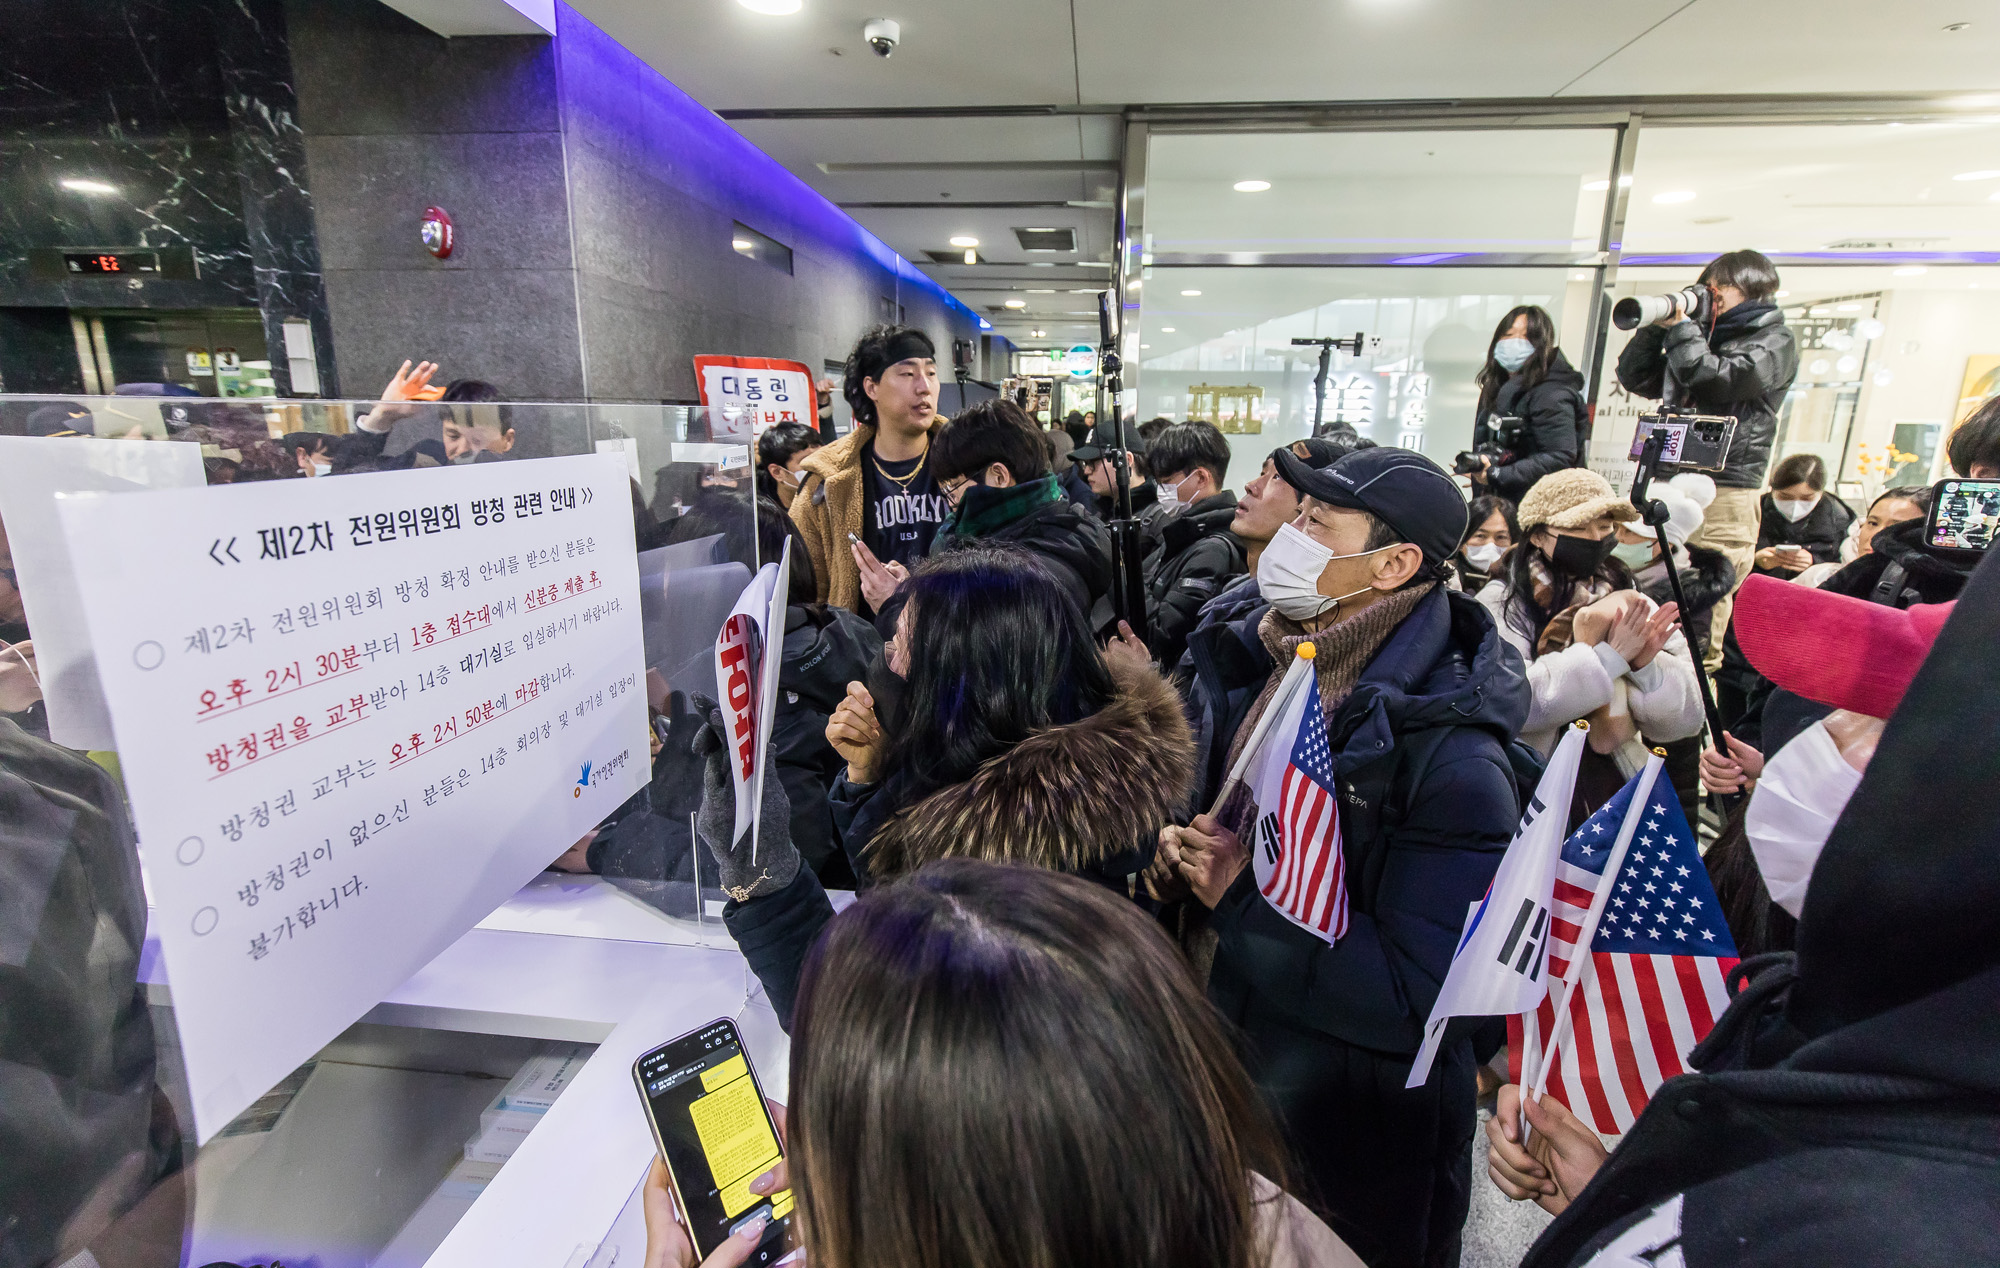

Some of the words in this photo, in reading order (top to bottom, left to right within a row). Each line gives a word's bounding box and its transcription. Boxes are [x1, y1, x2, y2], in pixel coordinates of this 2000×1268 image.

[1670, 430, 1681, 456] STOP
[256, 520, 334, 560] 제2차
[348, 503, 461, 547] 전원위원회
[471, 497, 505, 526] 방청
[513, 492, 543, 519] 관련
[550, 487, 576, 512] 안내
[874, 493, 944, 530] ROOKLY
[184, 617, 256, 654] 제2차
[272, 586, 383, 635] 전원위원회
[395, 576, 429, 603] 방청
[441, 566, 470, 591] 확정
[479, 556, 520, 581] 안내를
[526, 544, 560, 569] 받으신
[565, 536, 596, 558] 분들은
[198, 679, 252, 715] 오후
[265, 661, 302, 692] 2시
[316, 632, 400, 677] 30분부터
[411, 622, 437, 647] 1층
[446, 596, 517, 636] 접수대에서
[524, 583, 558, 610] 신분증
[564, 574, 584, 595] 제출
[206, 716, 312, 773] 방청권을
[326, 679, 408, 727] 교부받아
[418, 664, 451, 693] 14층
[460, 640, 516, 674] 대기실로
[522, 613, 578, 650] 입실하시기
[583, 597, 623, 626] 바랍니다.
[800, 654, 821, 673] KOLON
[220, 789, 298, 843] 방청권
[312, 758, 376, 801] 교부는
[388, 732, 425, 765] 오후
[433, 716, 458, 744] 2시
[465, 693, 508, 728] 50분에
[515, 662, 575, 702] 마감합니다.
[237, 839, 333, 908] 방청권이
[350, 798, 410, 848] 없으신
[422, 768, 471, 808] 분들은
[480, 746, 508, 775] 14층
[516, 720, 551, 753] 회의장
[558, 710, 568, 730] 및
[575, 690, 603, 718] 대기실
[608, 672, 636, 700] 입장이
[247, 875, 369, 961] 불가합니다.
